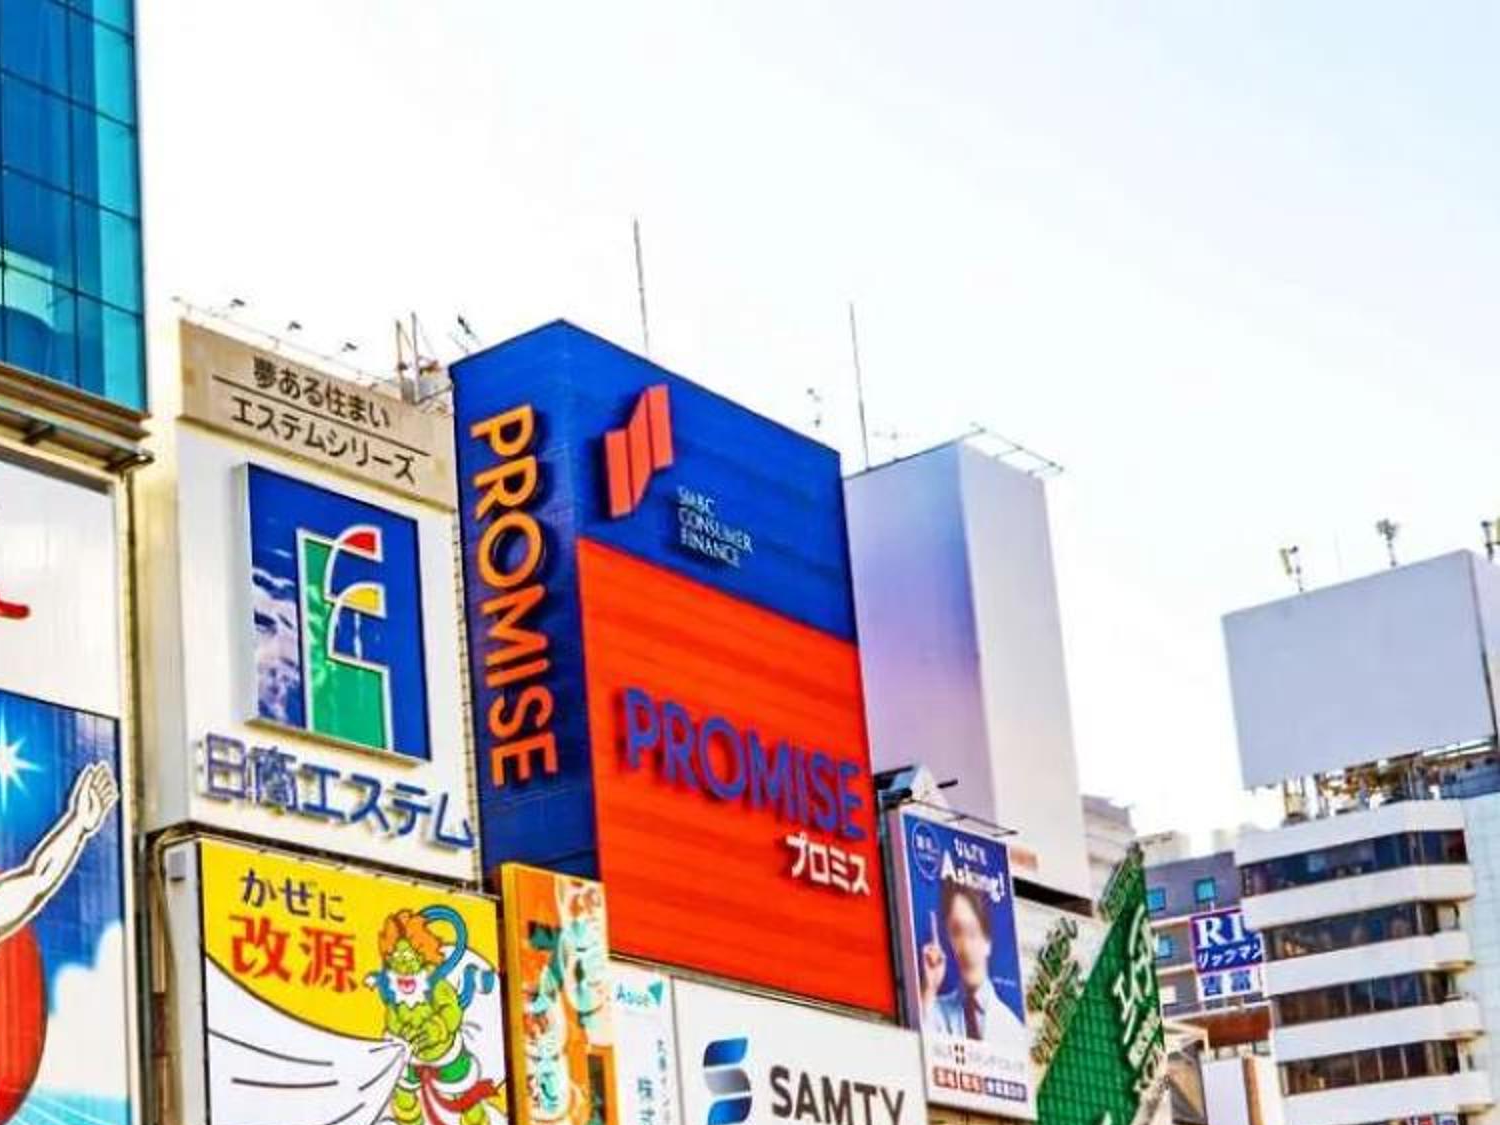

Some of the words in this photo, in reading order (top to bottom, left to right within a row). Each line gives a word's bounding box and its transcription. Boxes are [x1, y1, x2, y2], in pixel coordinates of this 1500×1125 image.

[252, 356, 391, 429] 夢ある住まい
[230, 396, 417, 484] エステムシリーズ
[470, 404, 562, 788] PROMISE
[621, 686, 868, 842] PROMISE
[240, 867, 347, 922] かぜに
[785, 834, 872, 896] プロミス
[228, 913, 358, 994] 改源
